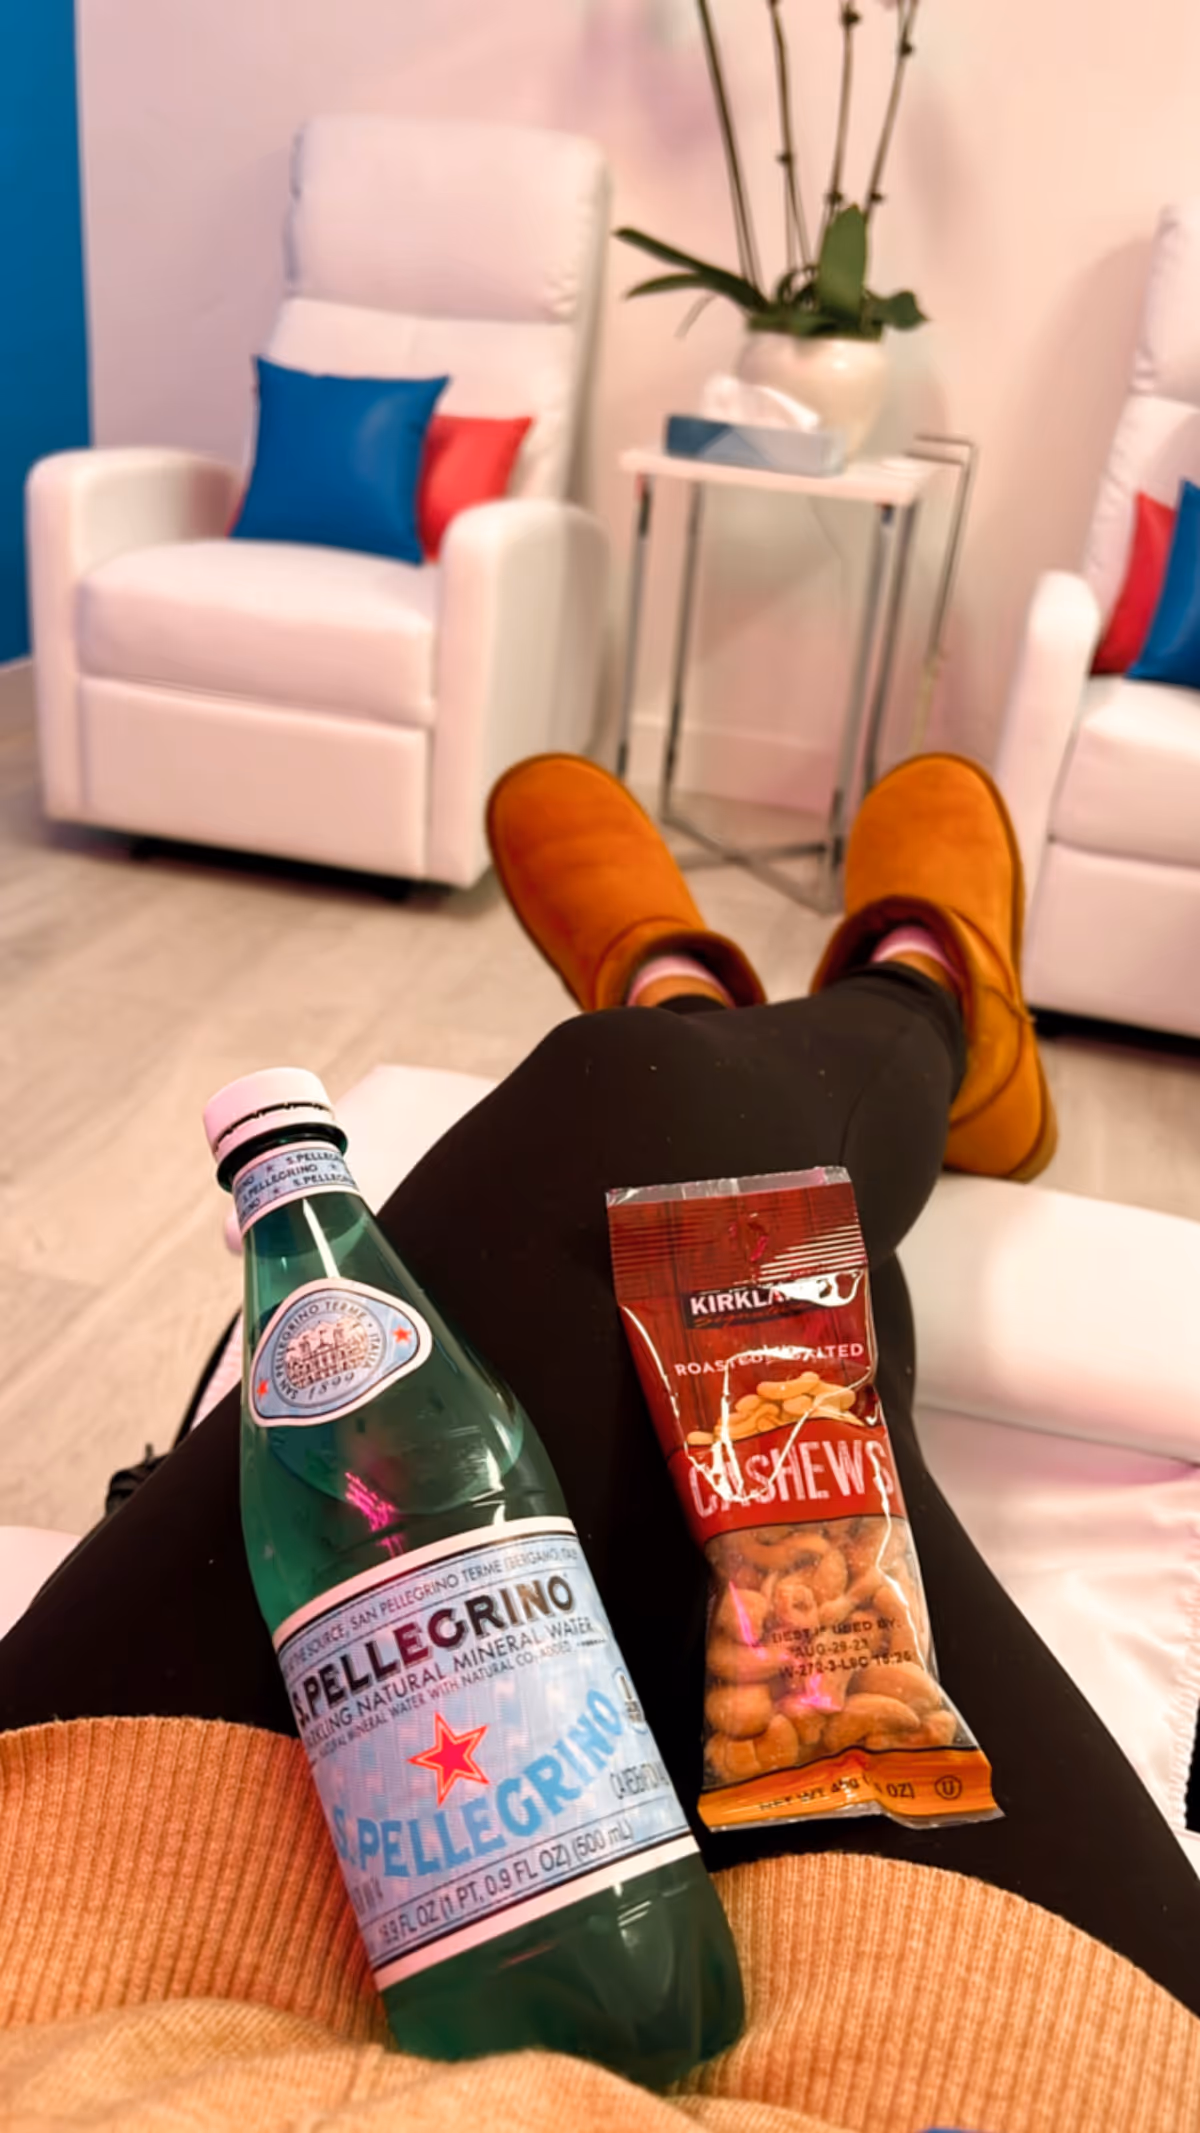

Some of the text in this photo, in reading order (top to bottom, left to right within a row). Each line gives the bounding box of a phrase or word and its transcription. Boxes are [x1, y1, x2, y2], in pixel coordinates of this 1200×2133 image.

[689, 1285, 787, 1316] KIRKLA
[279, 1379, 299, 1400] SAN
[324, 1301, 367, 1320] TERME
[308, 1371, 355, 1400] 1899
[675, 1349, 765, 1377] ROASTED
[688, 1440, 895, 1518] CASHEWS
[350, 1606, 378, 1631] SAN
[380, 1574, 459, 1615] PELLEGRINO
[461, 1560, 503, 1583] TERME
[356, 1662, 446, 1717] NATURAL
[453, 1629, 542, 1673] MINERAL
[549, 1616, 594, 1639] WATER
[388, 1693, 425, 1718] WATER
[426, 1680, 459, 1701] WITH
[461, 1661, 515, 1689] NATURAL
[416, 1899, 439, 1928] OZ
[485, 1867, 512, 1897] 0.9
[513, 1858, 539, 1884] FL
[538, 1843, 572, 1872] OZ)
[572, 1828, 606, 1863] (500
[607, 1817, 634, 1845] mL)
